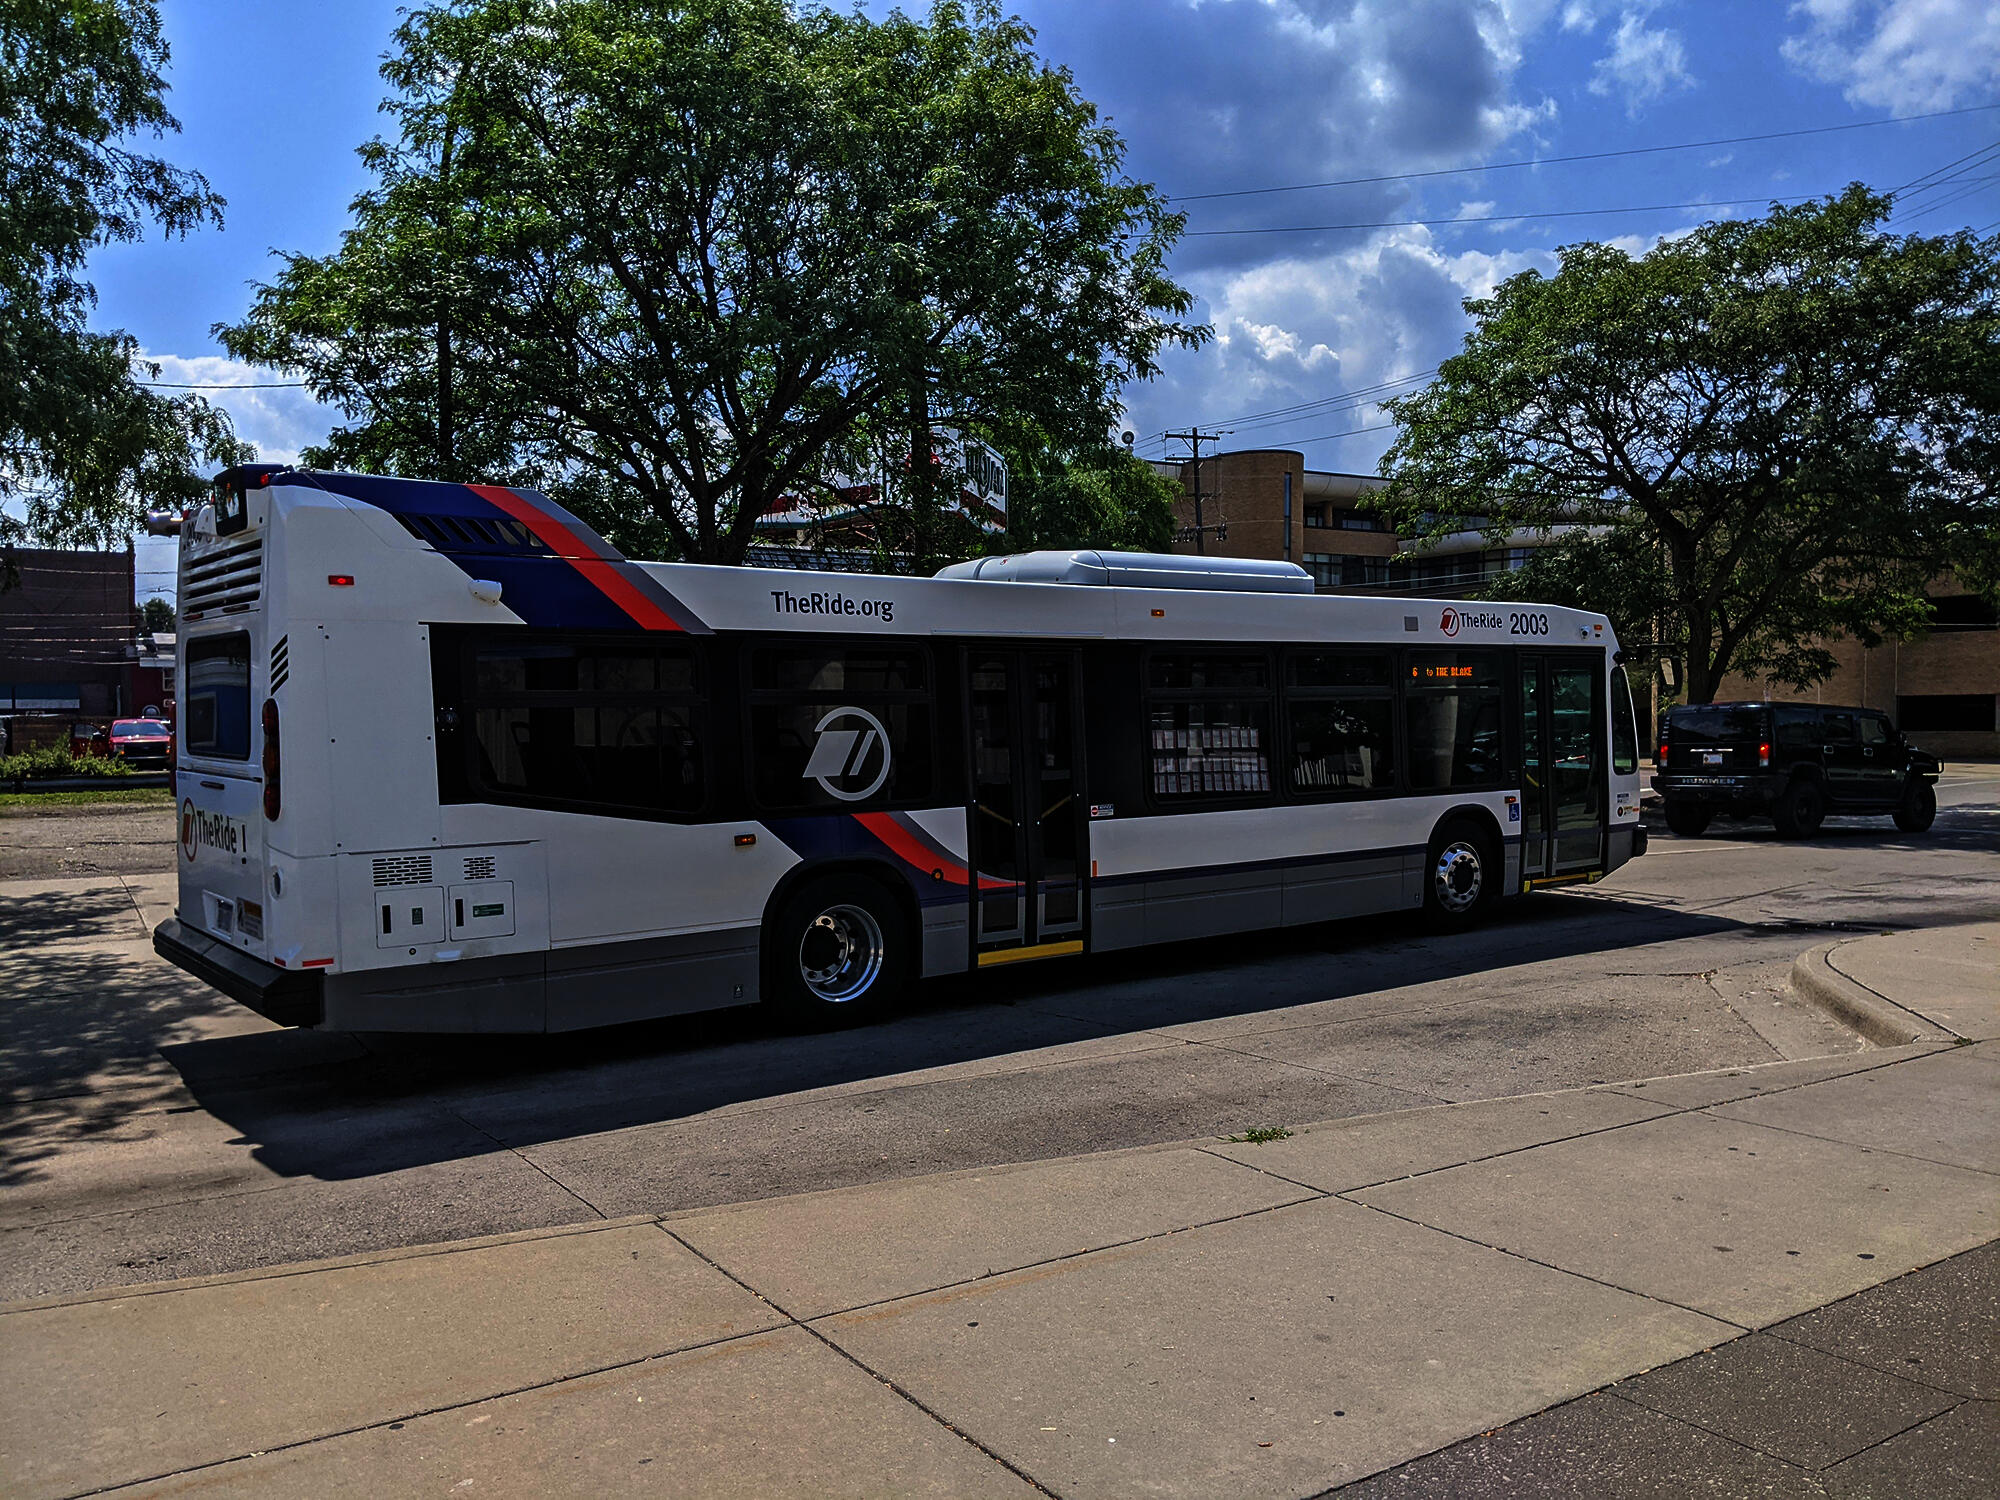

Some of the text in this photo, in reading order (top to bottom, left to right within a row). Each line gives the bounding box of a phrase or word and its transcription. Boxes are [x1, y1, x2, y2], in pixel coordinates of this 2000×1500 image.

[771, 590, 894, 622] TheRide.org
[1460, 612, 1549, 636] TheRide 2003
[1436, 667, 1448, 677] THE
[1450, 666, 1472, 677] BLAKE
[197, 810, 237, 854] TheRide
